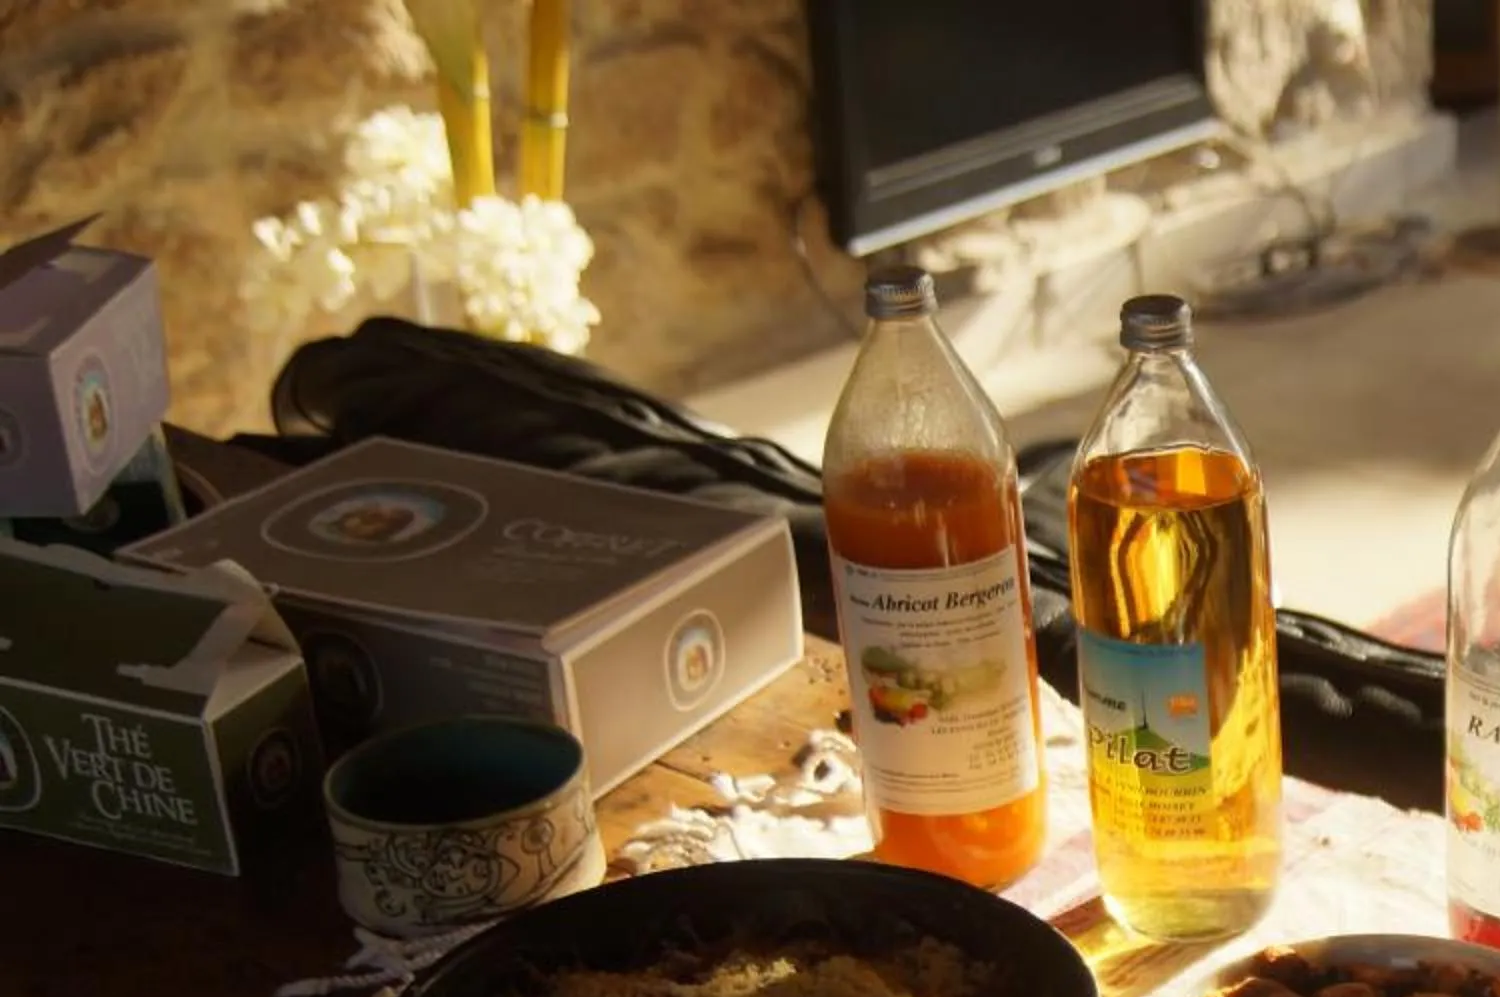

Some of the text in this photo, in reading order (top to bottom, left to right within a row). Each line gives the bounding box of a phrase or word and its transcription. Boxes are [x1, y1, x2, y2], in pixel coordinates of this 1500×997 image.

[870, 593, 938, 612] Abricot
[42, 733, 178, 794] VERT DE
[92, 779, 198, 826] CHINE
